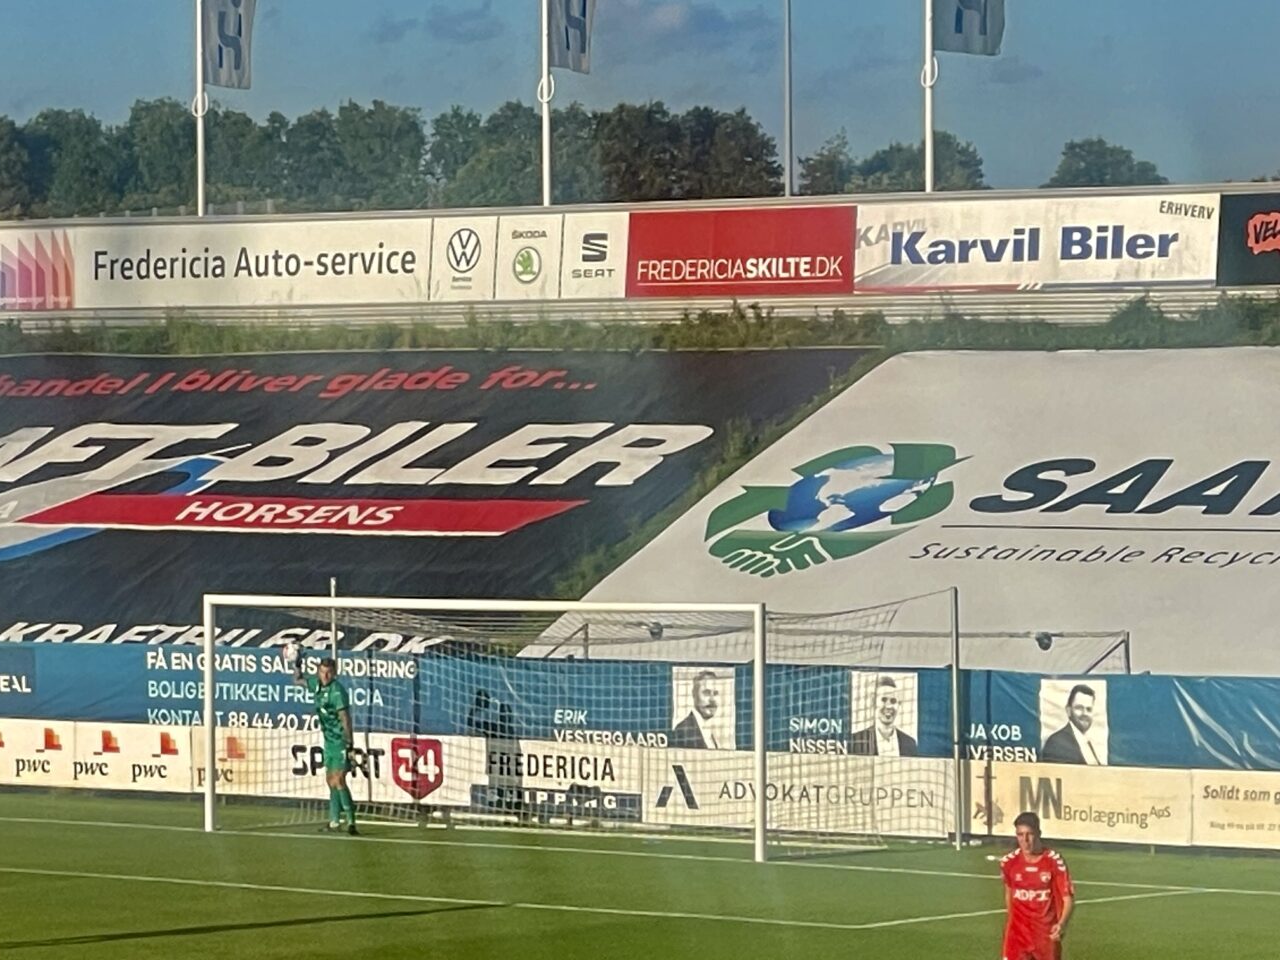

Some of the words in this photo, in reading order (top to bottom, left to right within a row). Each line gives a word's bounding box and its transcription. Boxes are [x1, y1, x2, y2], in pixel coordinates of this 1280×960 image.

[1159, 200, 1215, 221] ERHVERV
[890, 226, 1040, 265] Karvil
[1060, 224, 1179, 260] Biler
[94, 248, 225, 280] Fredericia
[234, 241, 417, 278] Auto-service
[637, 255, 843, 281] FREDERICIASKILTE.DK
[571, 268, 616, 279] SEAT
[172, 369, 324, 393] bliver
[318, 365, 470, 399] glade
[479, 365, 599, 391] for...
[196, 420, 715, 487] BILER
[174, 501, 406, 527] HORSENS
[909, 542, 1146, 564] Sustainable
[146, 647, 168, 671] FÅ
[172, 652, 193, 671] EN
[284, 685, 384, 707] FREICIA
[146, 708, 224, 727] KONTAT
[228, 711, 249, 728] 88
[252, 713, 274, 729] 44
[276, 714, 299, 730] 20
[553, 709, 588, 725] ERIK
[788, 717, 843, 734] SIMON
[553, 729, 669, 748] VESTERGAARD
[788, 738, 848, 755] NISSEN
[15, 758, 51, 777] pwc
[73, 760, 109, 780] pwc
[131, 763, 168, 783] pwc
[291, 744, 385, 780] SPRT
[488, 751, 616, 782] FREDERICIA
[1202, 784, 1240, 802] Solidt
[1243, 788, 1270, 802] som
[1063, 805, 1148, 829] Brolægning
[1148, 806, 1171, 819] ApS
